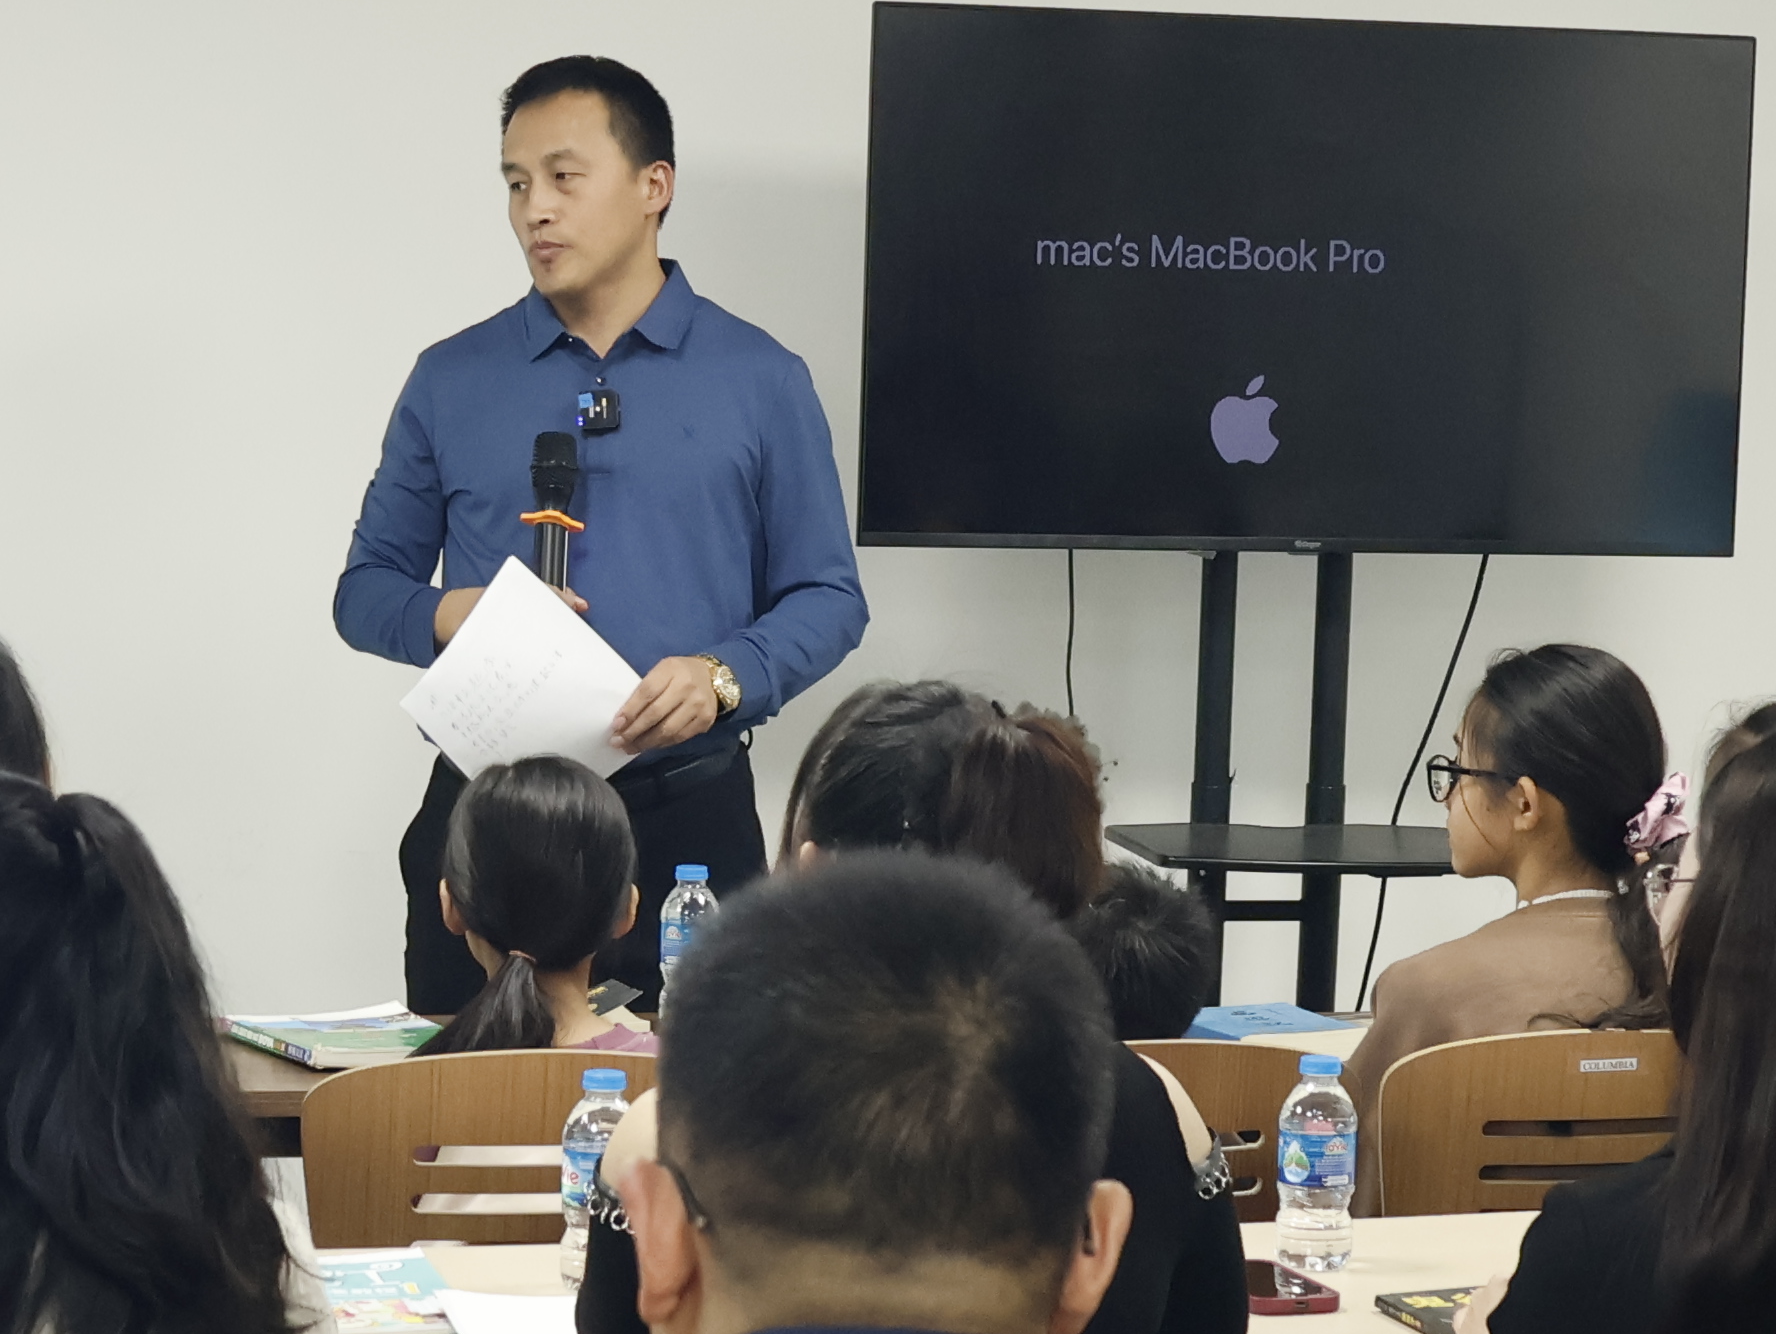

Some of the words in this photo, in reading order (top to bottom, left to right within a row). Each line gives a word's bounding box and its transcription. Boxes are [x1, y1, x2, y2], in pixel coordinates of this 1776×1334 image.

[1035, 232, 1140, 268] mac's
[1150, 233, 1318, 273] MacBook
[1327, 239, 1386, 274] Pro
